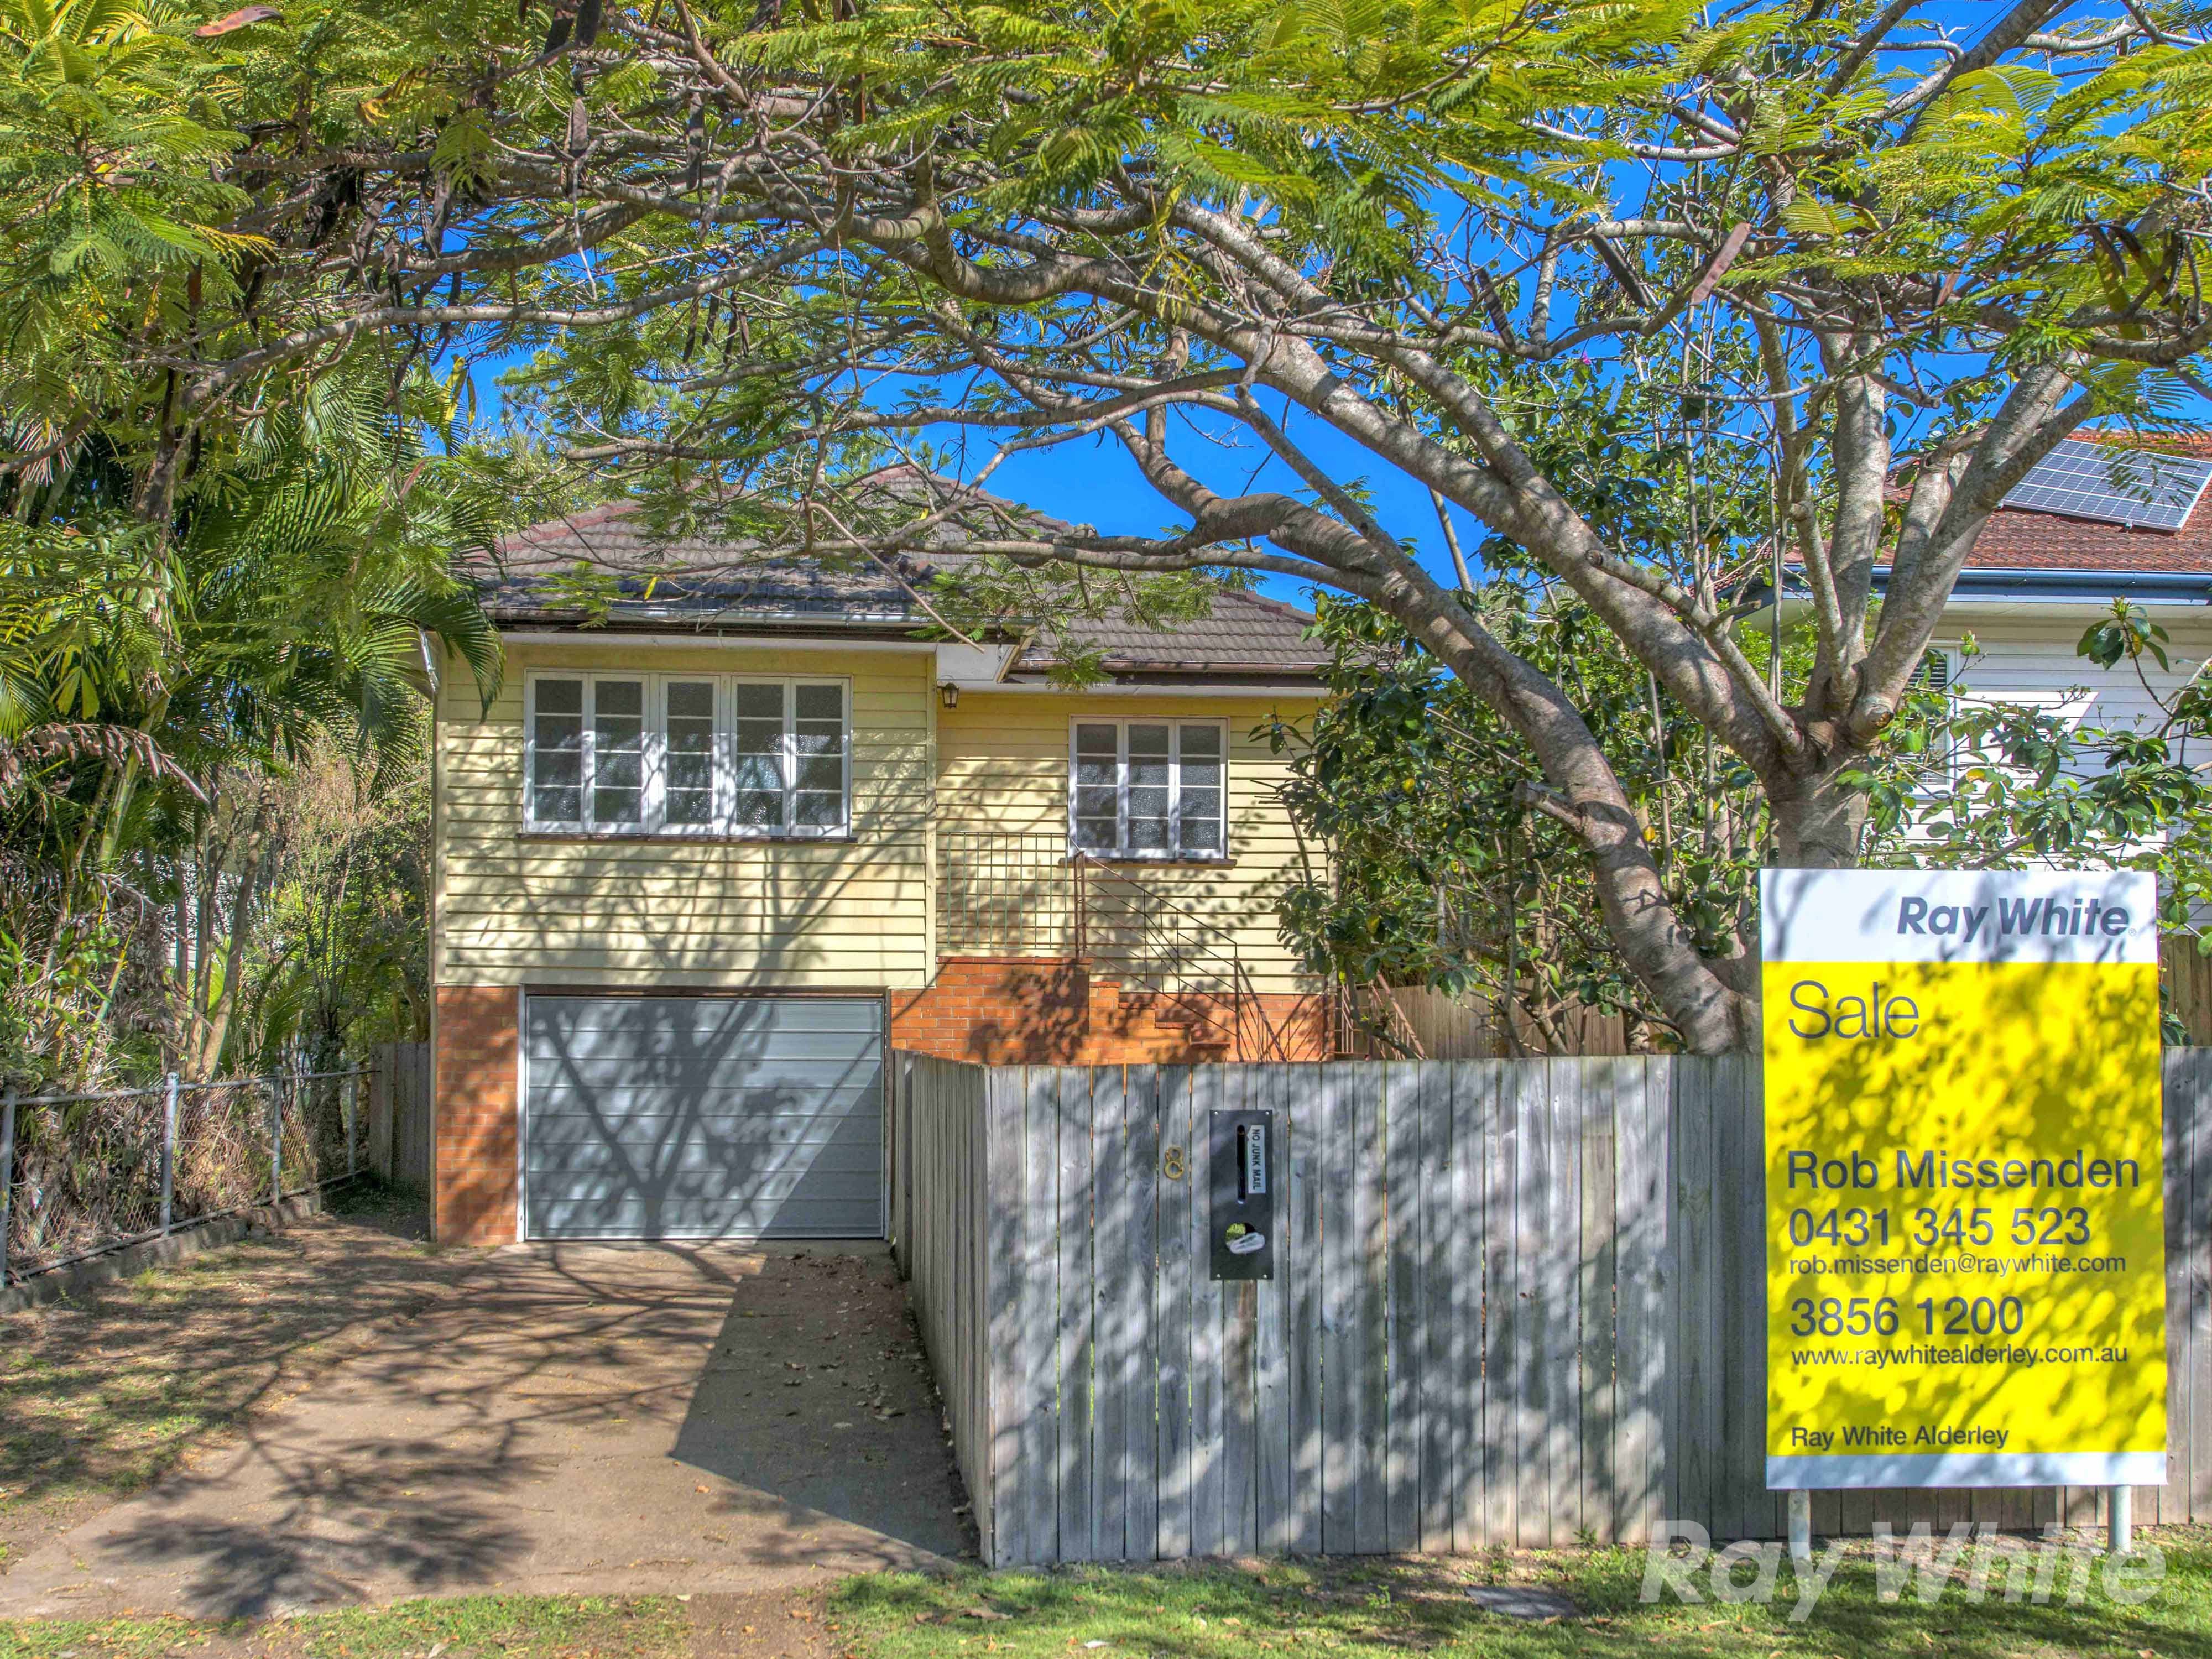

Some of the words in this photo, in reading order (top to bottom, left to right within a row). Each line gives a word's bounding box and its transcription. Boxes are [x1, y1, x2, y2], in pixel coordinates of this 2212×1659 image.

[1897, 896, 1989, 943] Ray
[1998, 897, 2130, 936] White
[1788, 980, 1919, 1039] Sale
[1251, 1129, 1260, 1141] NO
[1164, 1146, 1184, 1180] 8
[1251, 1143, 1260, 1166] JUNK
[1788, 1150, 1878, 1189] Rob
[1897, 1149, 2139, 1189] Missenden
[1252, 1168, 1261, 1190] MAIL
[1788, 1208, 1888, 1247] 0431
[1913, 1208, 1994, 1246] 345
[2011, 1207, 2091, 1245] 523
[1790, 1253, 2126, 1278] rob.missenden@raywhite.com
[1791, 1297, 1899, 1337] 3856
[1917, 1296, 2023, 1335] 1200
[1791, 1344, 2128, 1370] www.raywhitealderley.com.au
[1792, 1427, 1834, 1452] Ray
[1843, 1426, 1907, 1447] White
[1914, 1425, 2009, 1449] Alderley
